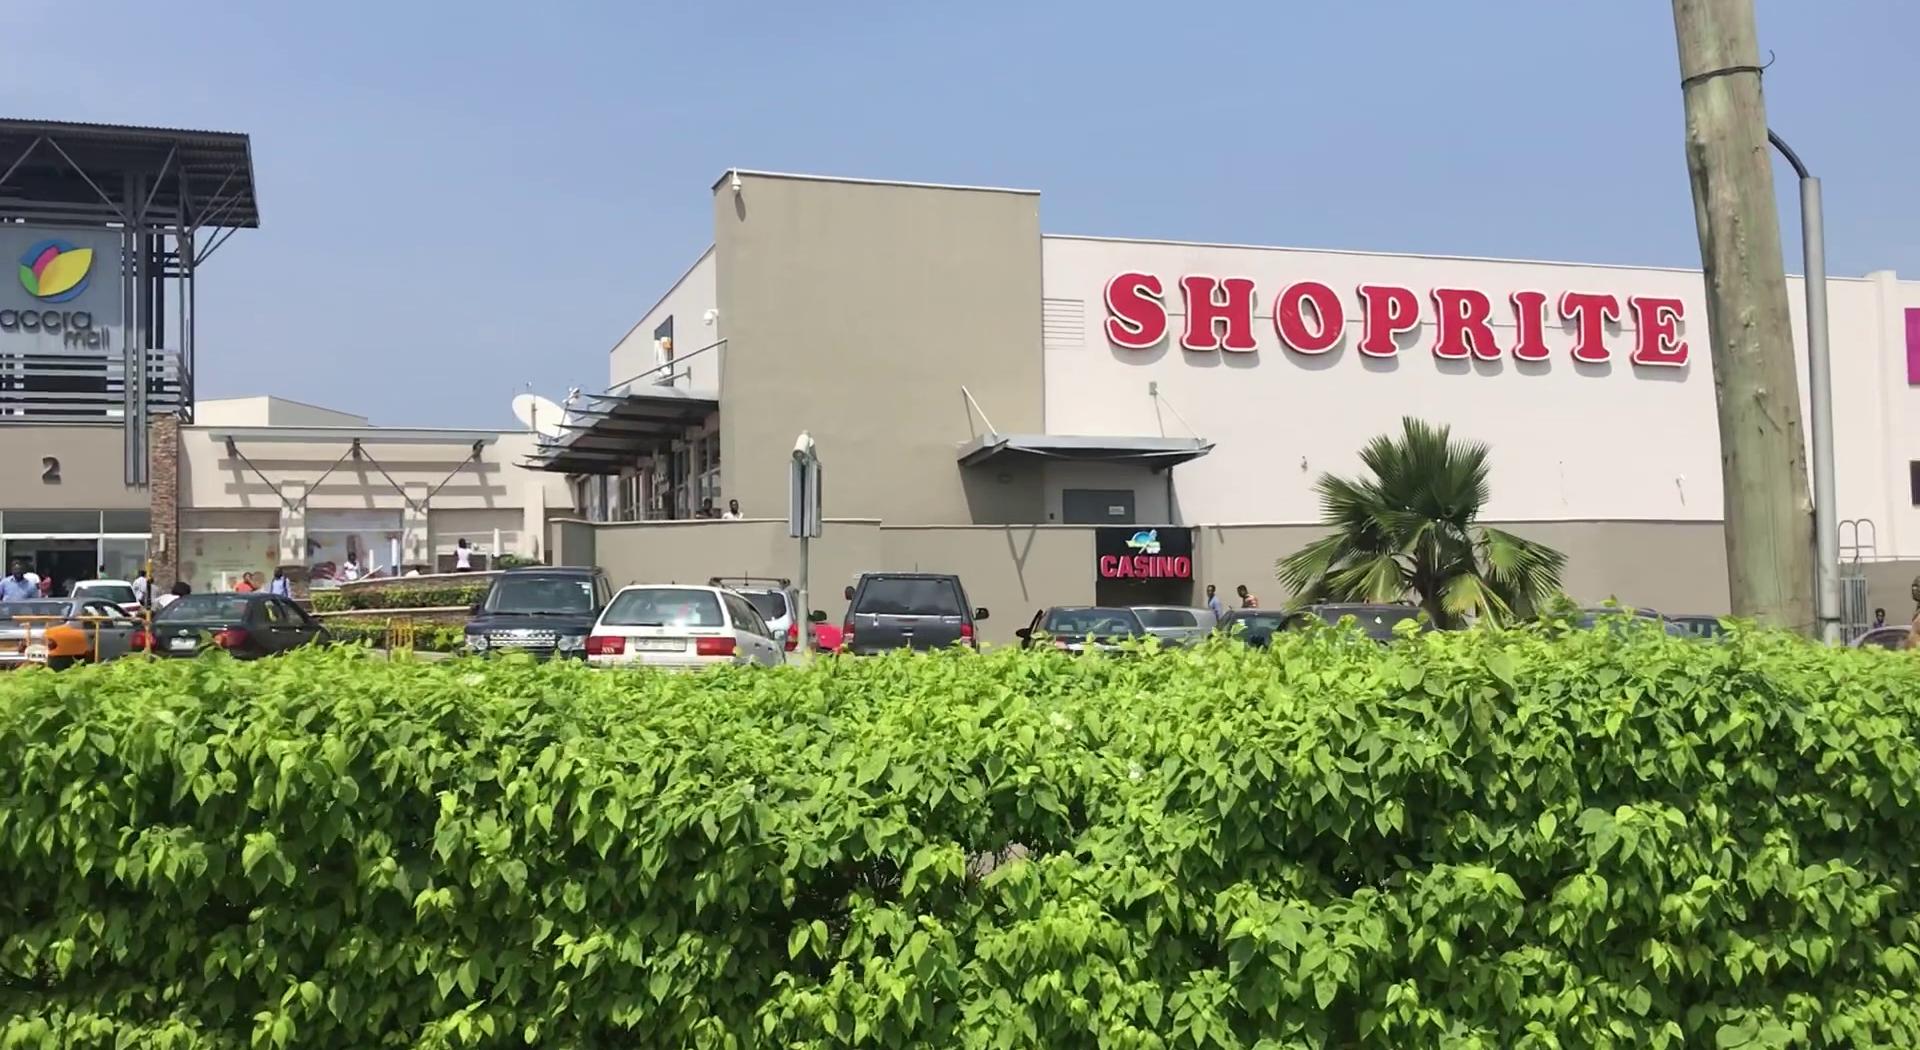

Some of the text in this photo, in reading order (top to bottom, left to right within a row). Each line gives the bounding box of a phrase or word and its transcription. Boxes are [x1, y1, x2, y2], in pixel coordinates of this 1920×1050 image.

[0, 309, 92, 331] accra
[1105, 271, 1690, 366] SHOPRITE
[63, 327, 110, 350] mall
[42, 456, 61, 485] 2
[1101, 555, 1191, 578] CASINO
